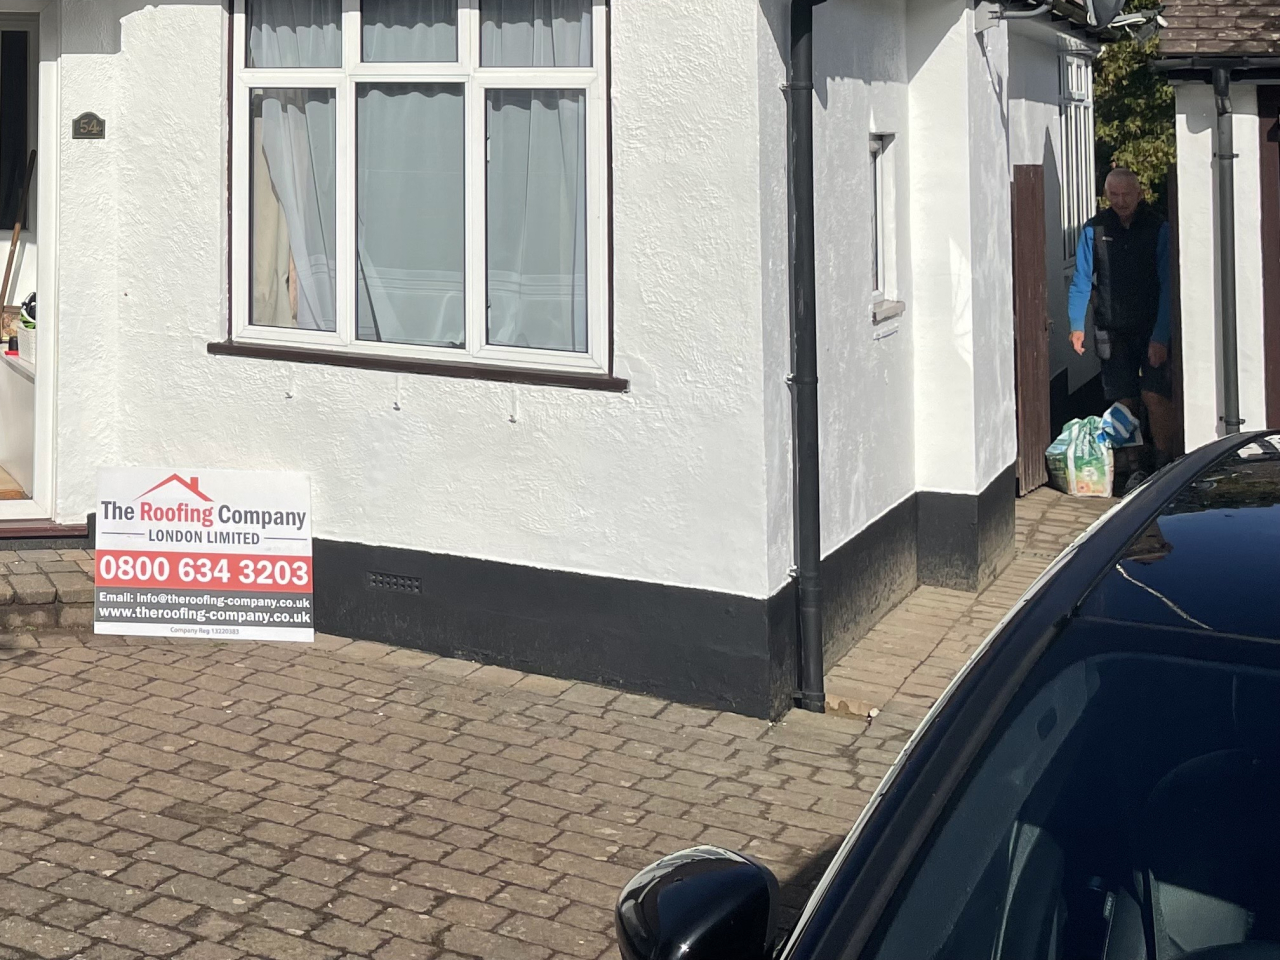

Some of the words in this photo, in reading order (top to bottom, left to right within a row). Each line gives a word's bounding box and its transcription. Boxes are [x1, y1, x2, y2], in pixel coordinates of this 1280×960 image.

[80, 119, 99, 134] 54
[101, 501, 134, 520] The
[140, 502, 214, 527] Roofing
[219, 504, 306, 531] Company
[149, 530, 204, 543] LONDON
[208, 531, 259, 545] LIMITED
[100, 555, 170, 581] 0800
[178, 558, 230, 583] 634
[239, 560, 308, 585] 3203
[99, 592, 134, 602] Email:
[137, 593, 310, 608] info@theroofing-company.co.uk
[99, 606, 310, 623] www.theroofing-company.co.uk
[198, 627, 210, 635] Reg
